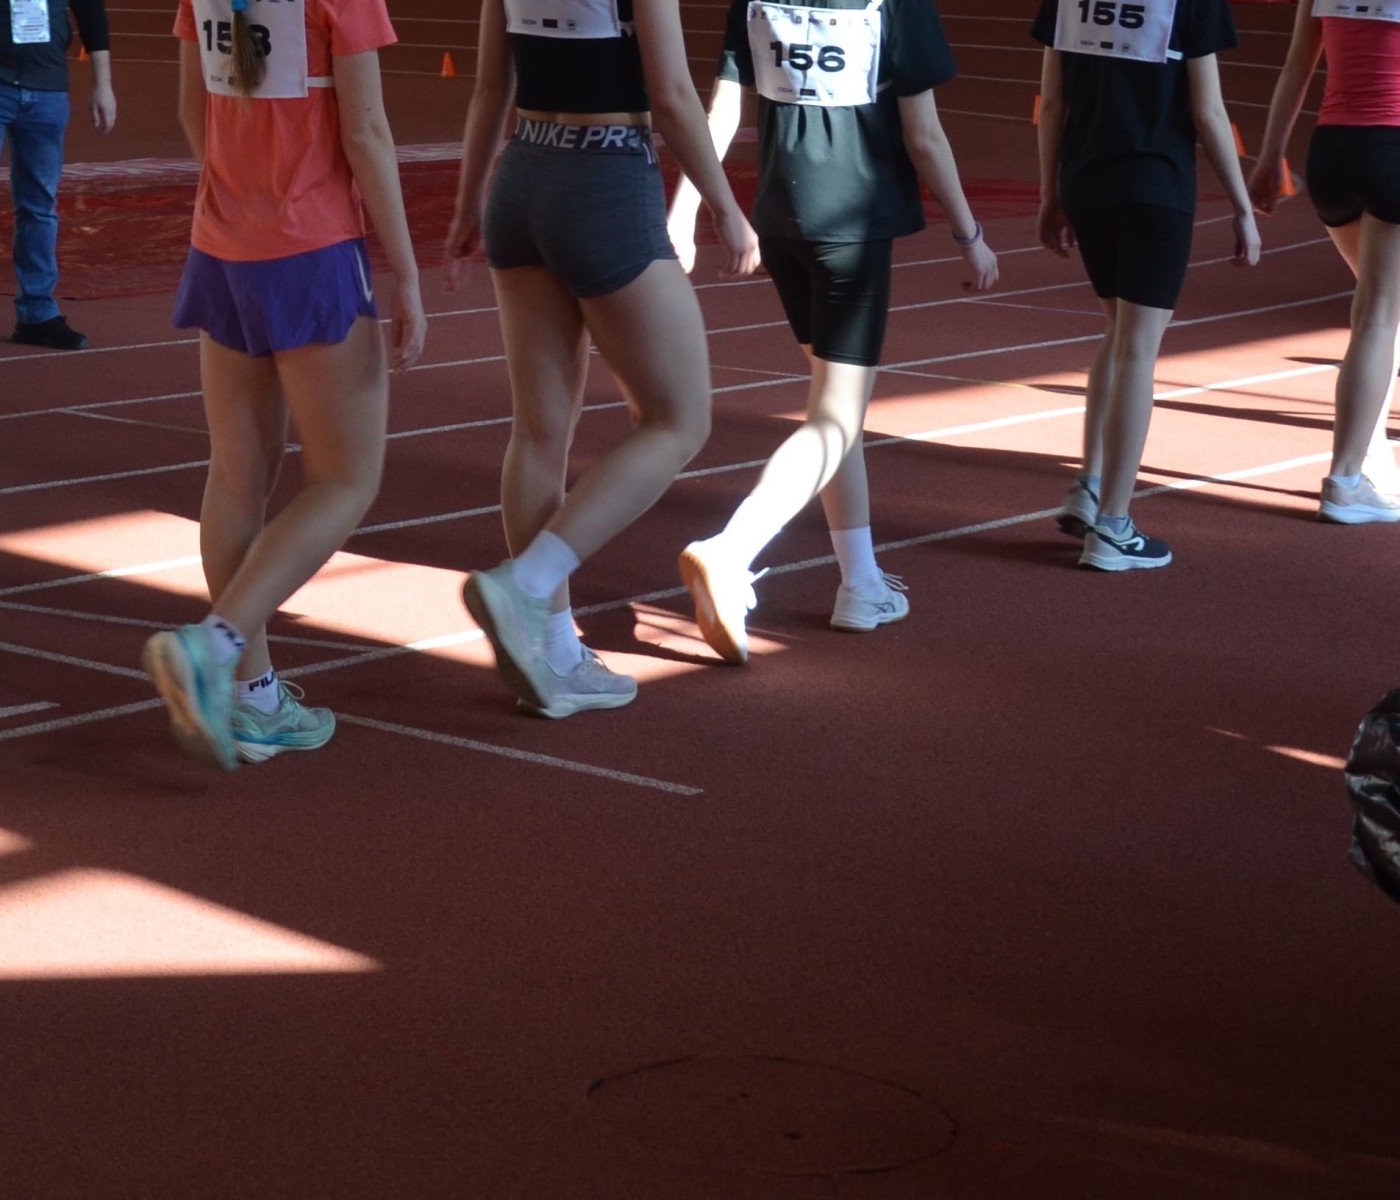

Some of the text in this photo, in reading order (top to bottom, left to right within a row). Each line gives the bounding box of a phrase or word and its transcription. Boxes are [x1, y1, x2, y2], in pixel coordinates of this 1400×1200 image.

[1078, 0, 1145, 29] 155
[769, 40, 846, 73] 156
[520, 118, 580, 149] NIKE
